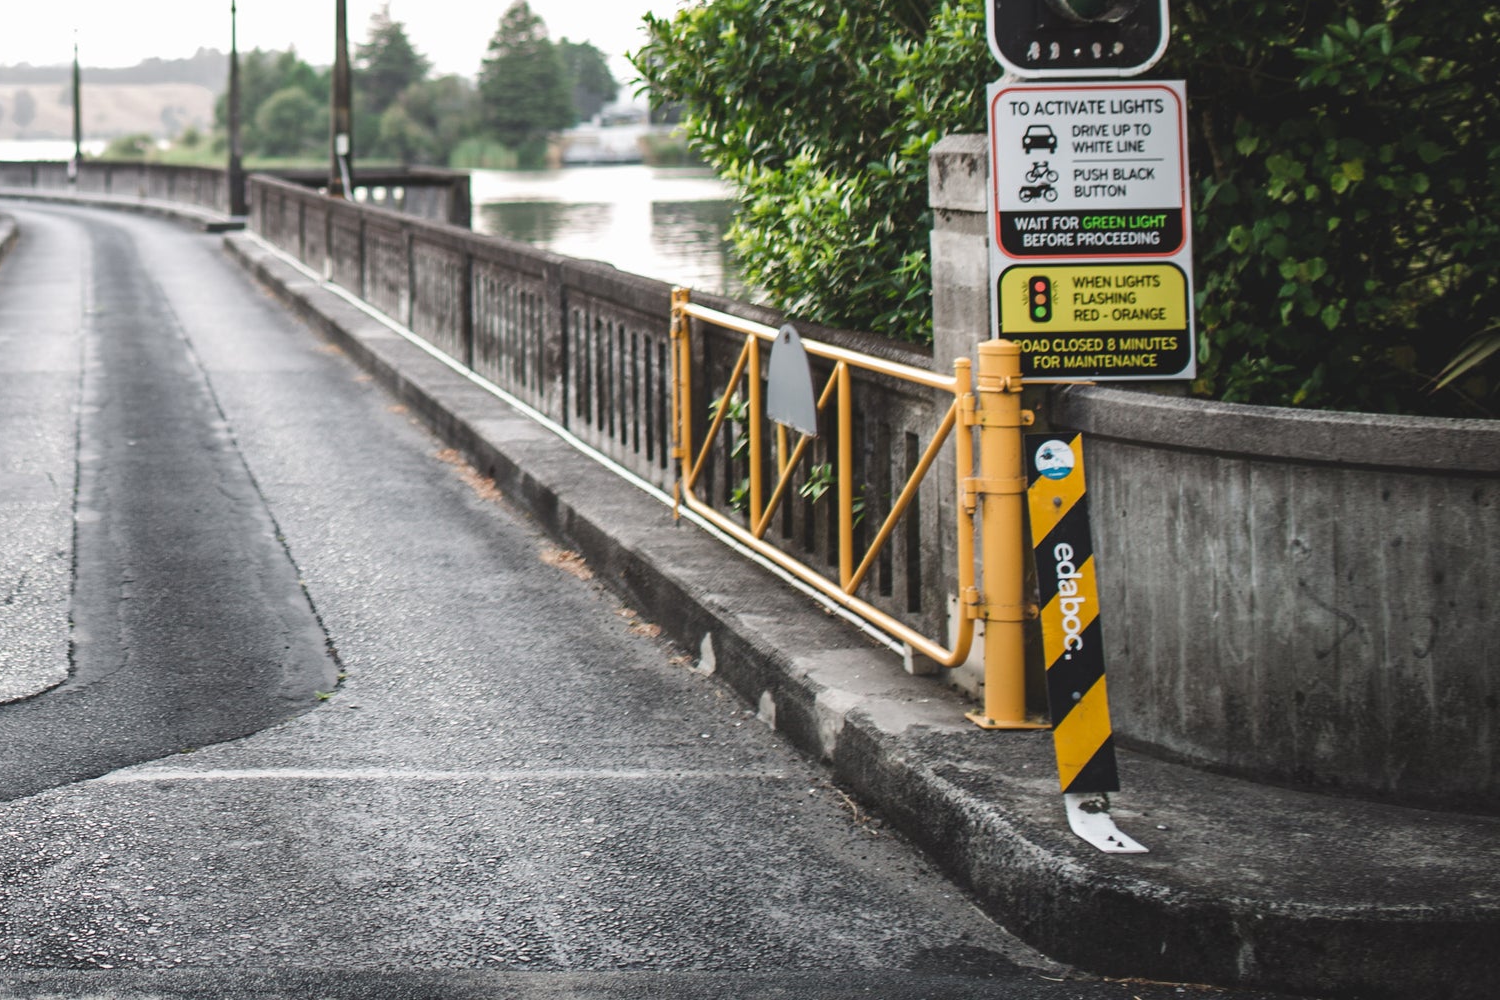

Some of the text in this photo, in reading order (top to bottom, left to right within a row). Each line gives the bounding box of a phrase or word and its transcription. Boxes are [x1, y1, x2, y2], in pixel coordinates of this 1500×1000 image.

[1010, 99, 1164, 116] TO ACTIVATE LIGHTS
[1072, 123, 1152, 137] DRIVE UP TO
[1072, 140, 1145, 153] WHITE LINE
[1073, 168, 1156, 181] PUSH BLACK
[1074, 185, 1127, 197] BUTTON
[1014, 214, 1167, 230] WAIT FOR GREEN LIGHT
[1023, 231, 1161, 247] BEFORE PROCEEDING
[1072, 275, 1161, 288] WHEN LIGHTS
[1073, 292, 1137, 305] FLASHING
[1074, 309, 1100, 321] RED
[1112, 308, 1167, 321] ORANGE
[1052, 338, 1104, 352] CLOSED
[1107, 338, 1116, 350] 8
[1119, 337, 1178, 350] MINUTES
[1033, 354, 1158, 369] FOR MAINTENANCE
